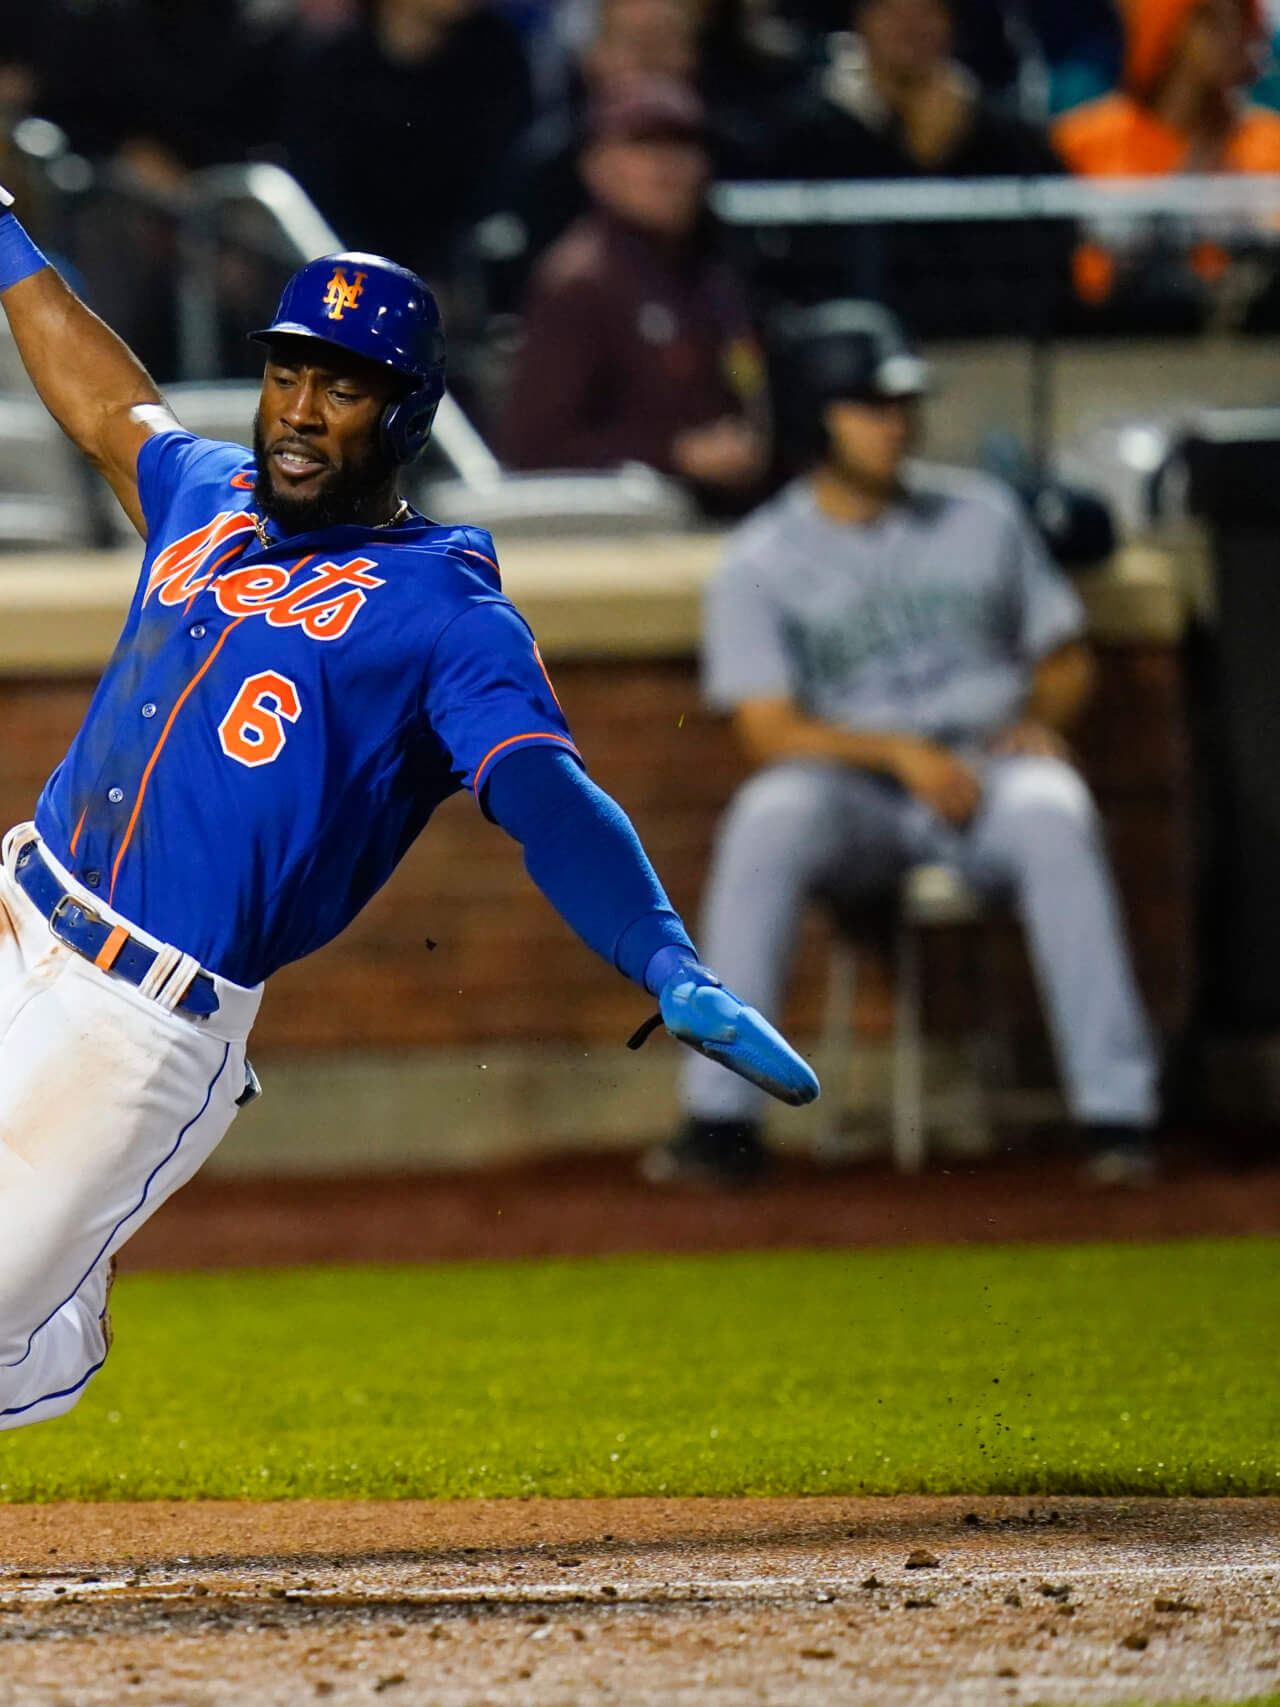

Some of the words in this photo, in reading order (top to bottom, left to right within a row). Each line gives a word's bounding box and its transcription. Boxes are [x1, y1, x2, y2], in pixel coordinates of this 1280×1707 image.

[323, 267, 368, 320] NY
[141, 510, 387, 641] Mets
[217, 669, 302, 768] 6
